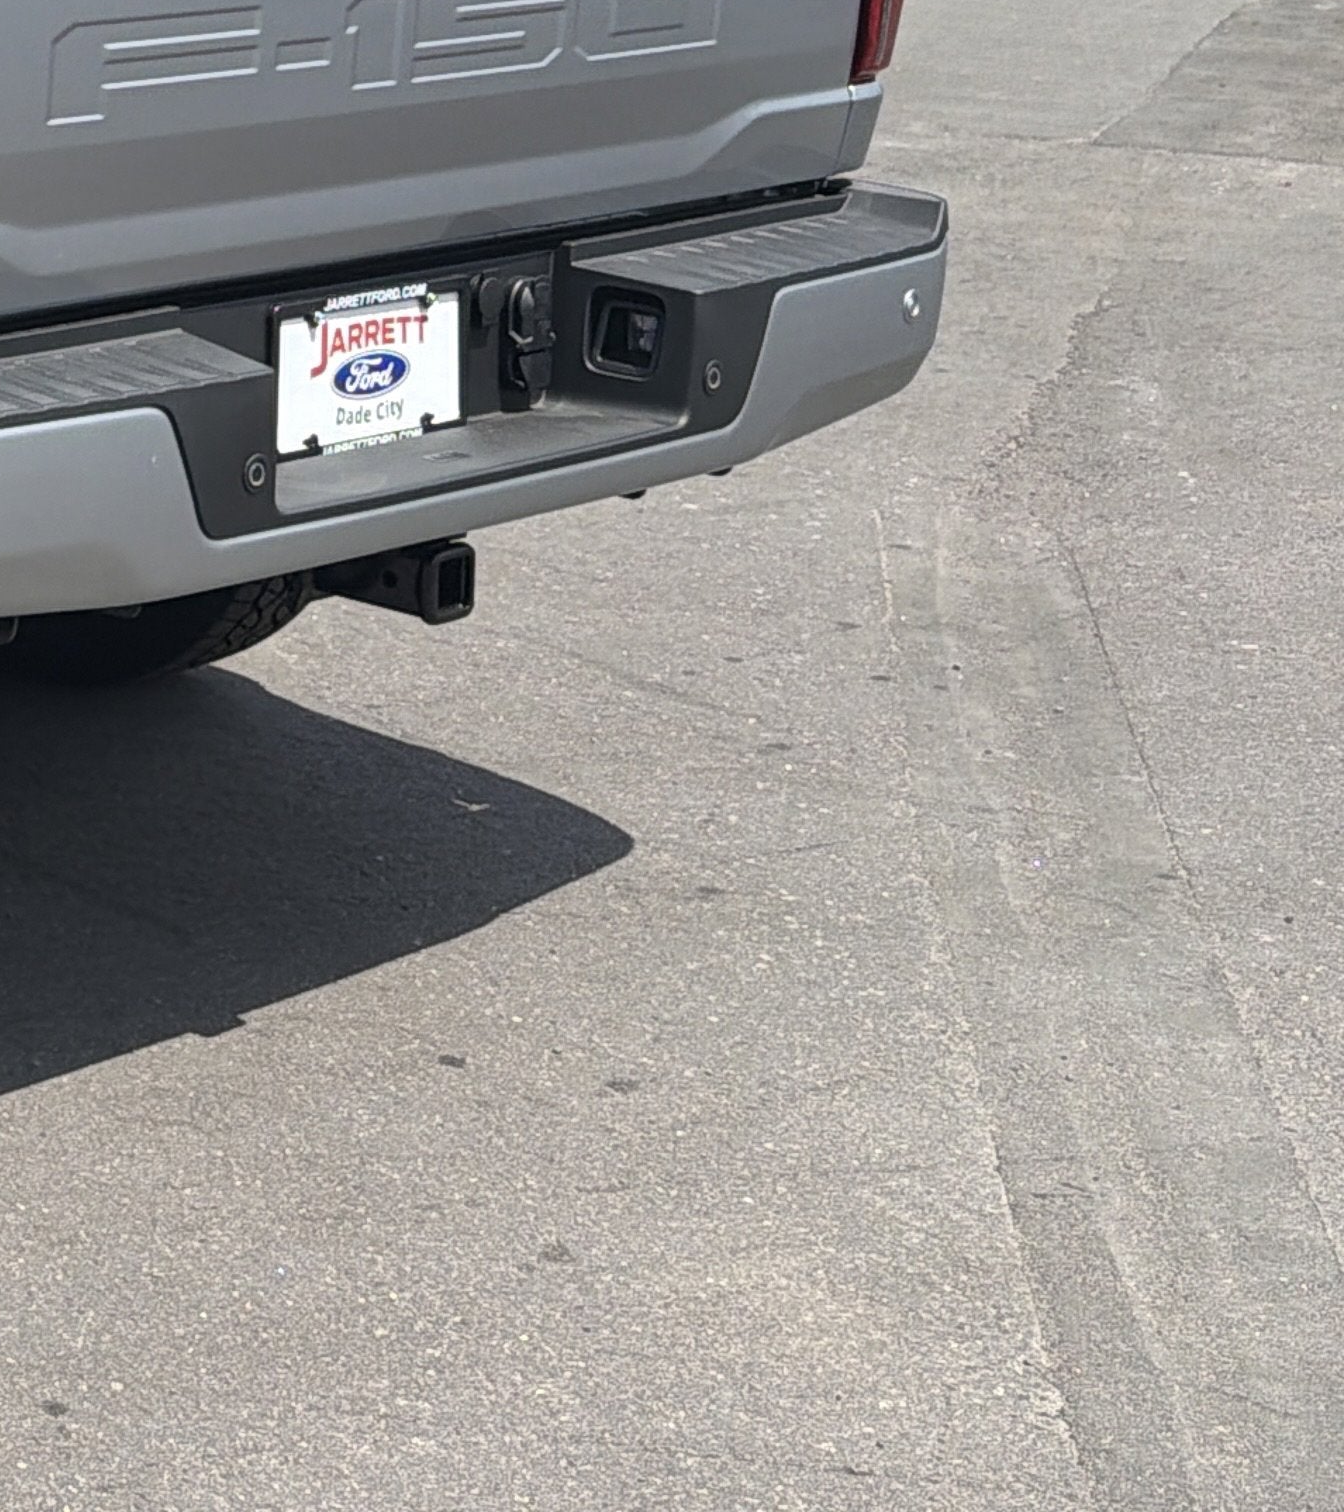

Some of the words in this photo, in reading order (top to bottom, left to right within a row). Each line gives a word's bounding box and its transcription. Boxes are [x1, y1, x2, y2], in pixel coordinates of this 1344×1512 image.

[311, 315, 429, 378] JARRETT
[345, 357, 394, 393] Ford
[336, 406, 372, 425] Dade
[376, 399, 404, 420] City
